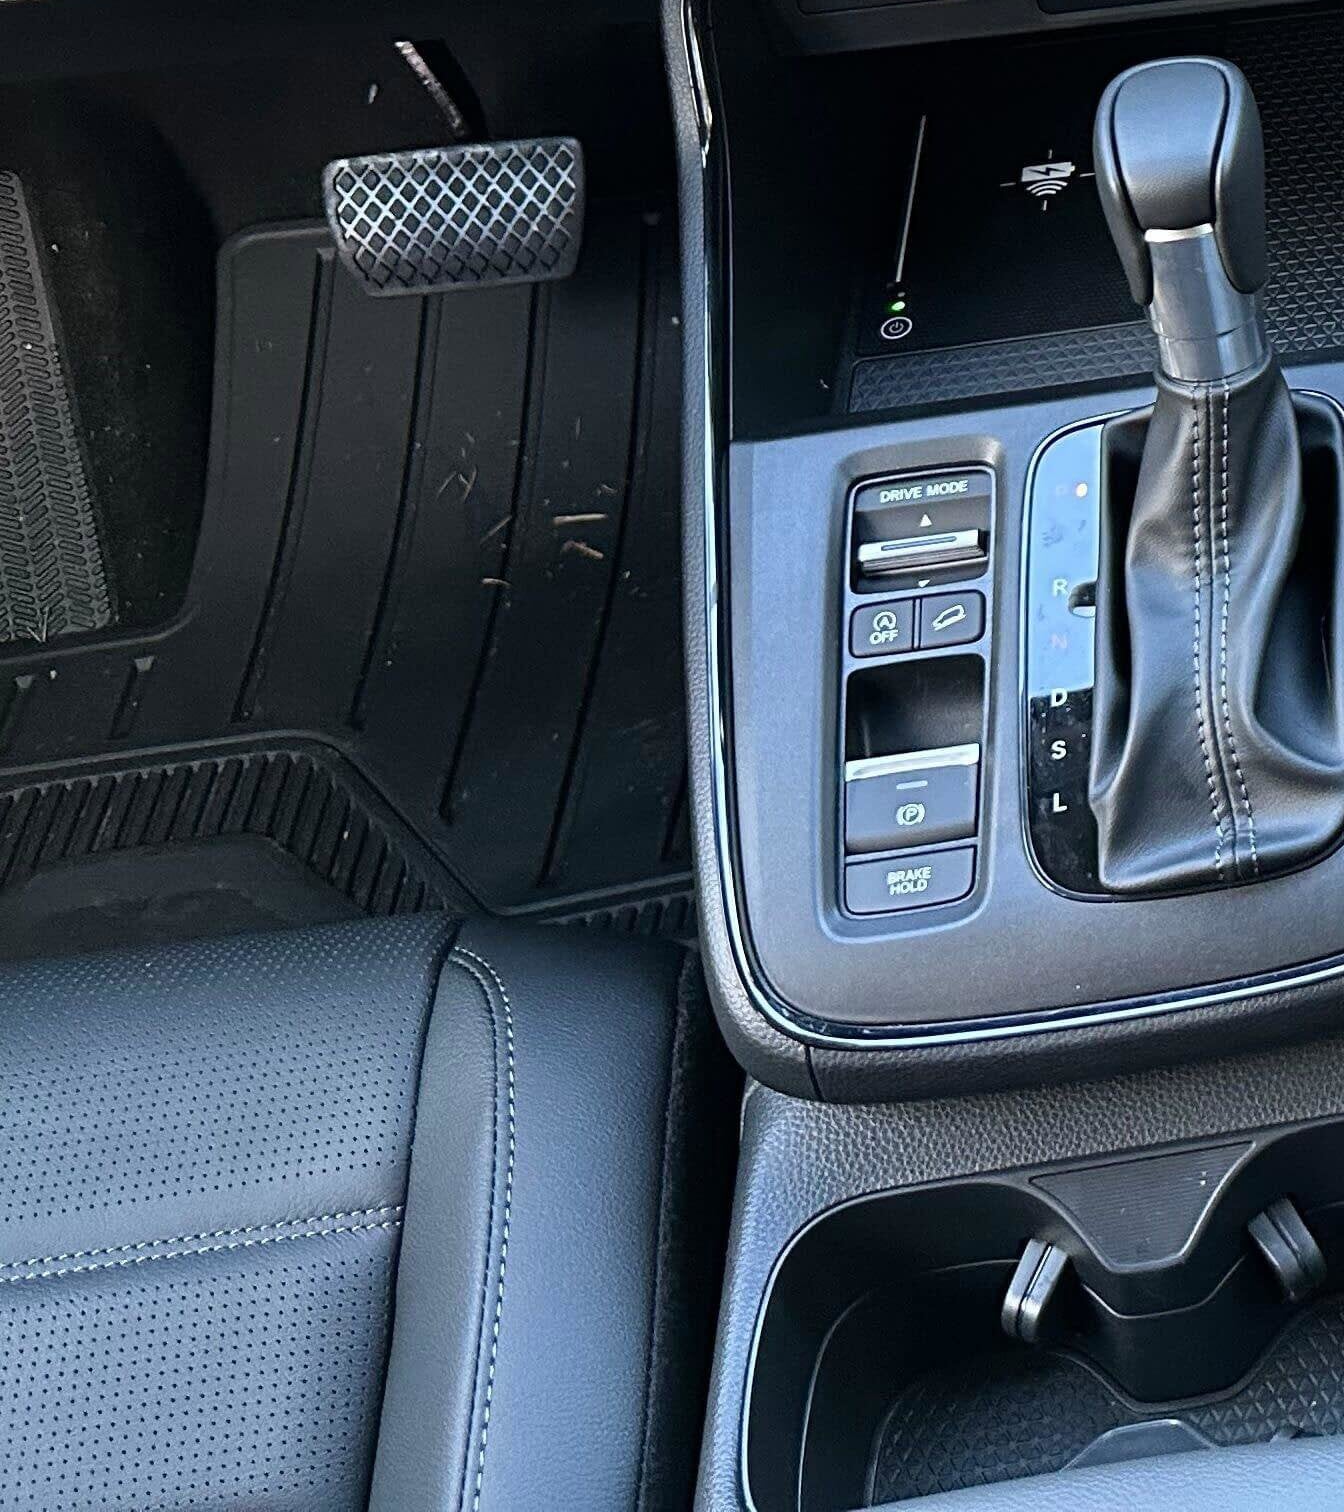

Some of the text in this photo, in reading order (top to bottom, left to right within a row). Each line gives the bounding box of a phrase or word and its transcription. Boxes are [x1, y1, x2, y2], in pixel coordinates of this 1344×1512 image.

[880, 480, 969, 503] DRIVE MODE
[1052, 578, 1069, 597] R
[869, 629, 899, 645] OFF
[1050, 689, 1068, 707] D
[1051, 740, 1067, 760] S
[1053, 794, 1068, 813] L
[887, 866, 931, 885] BRAKE
[889, 877, 928, 896] HOLD
